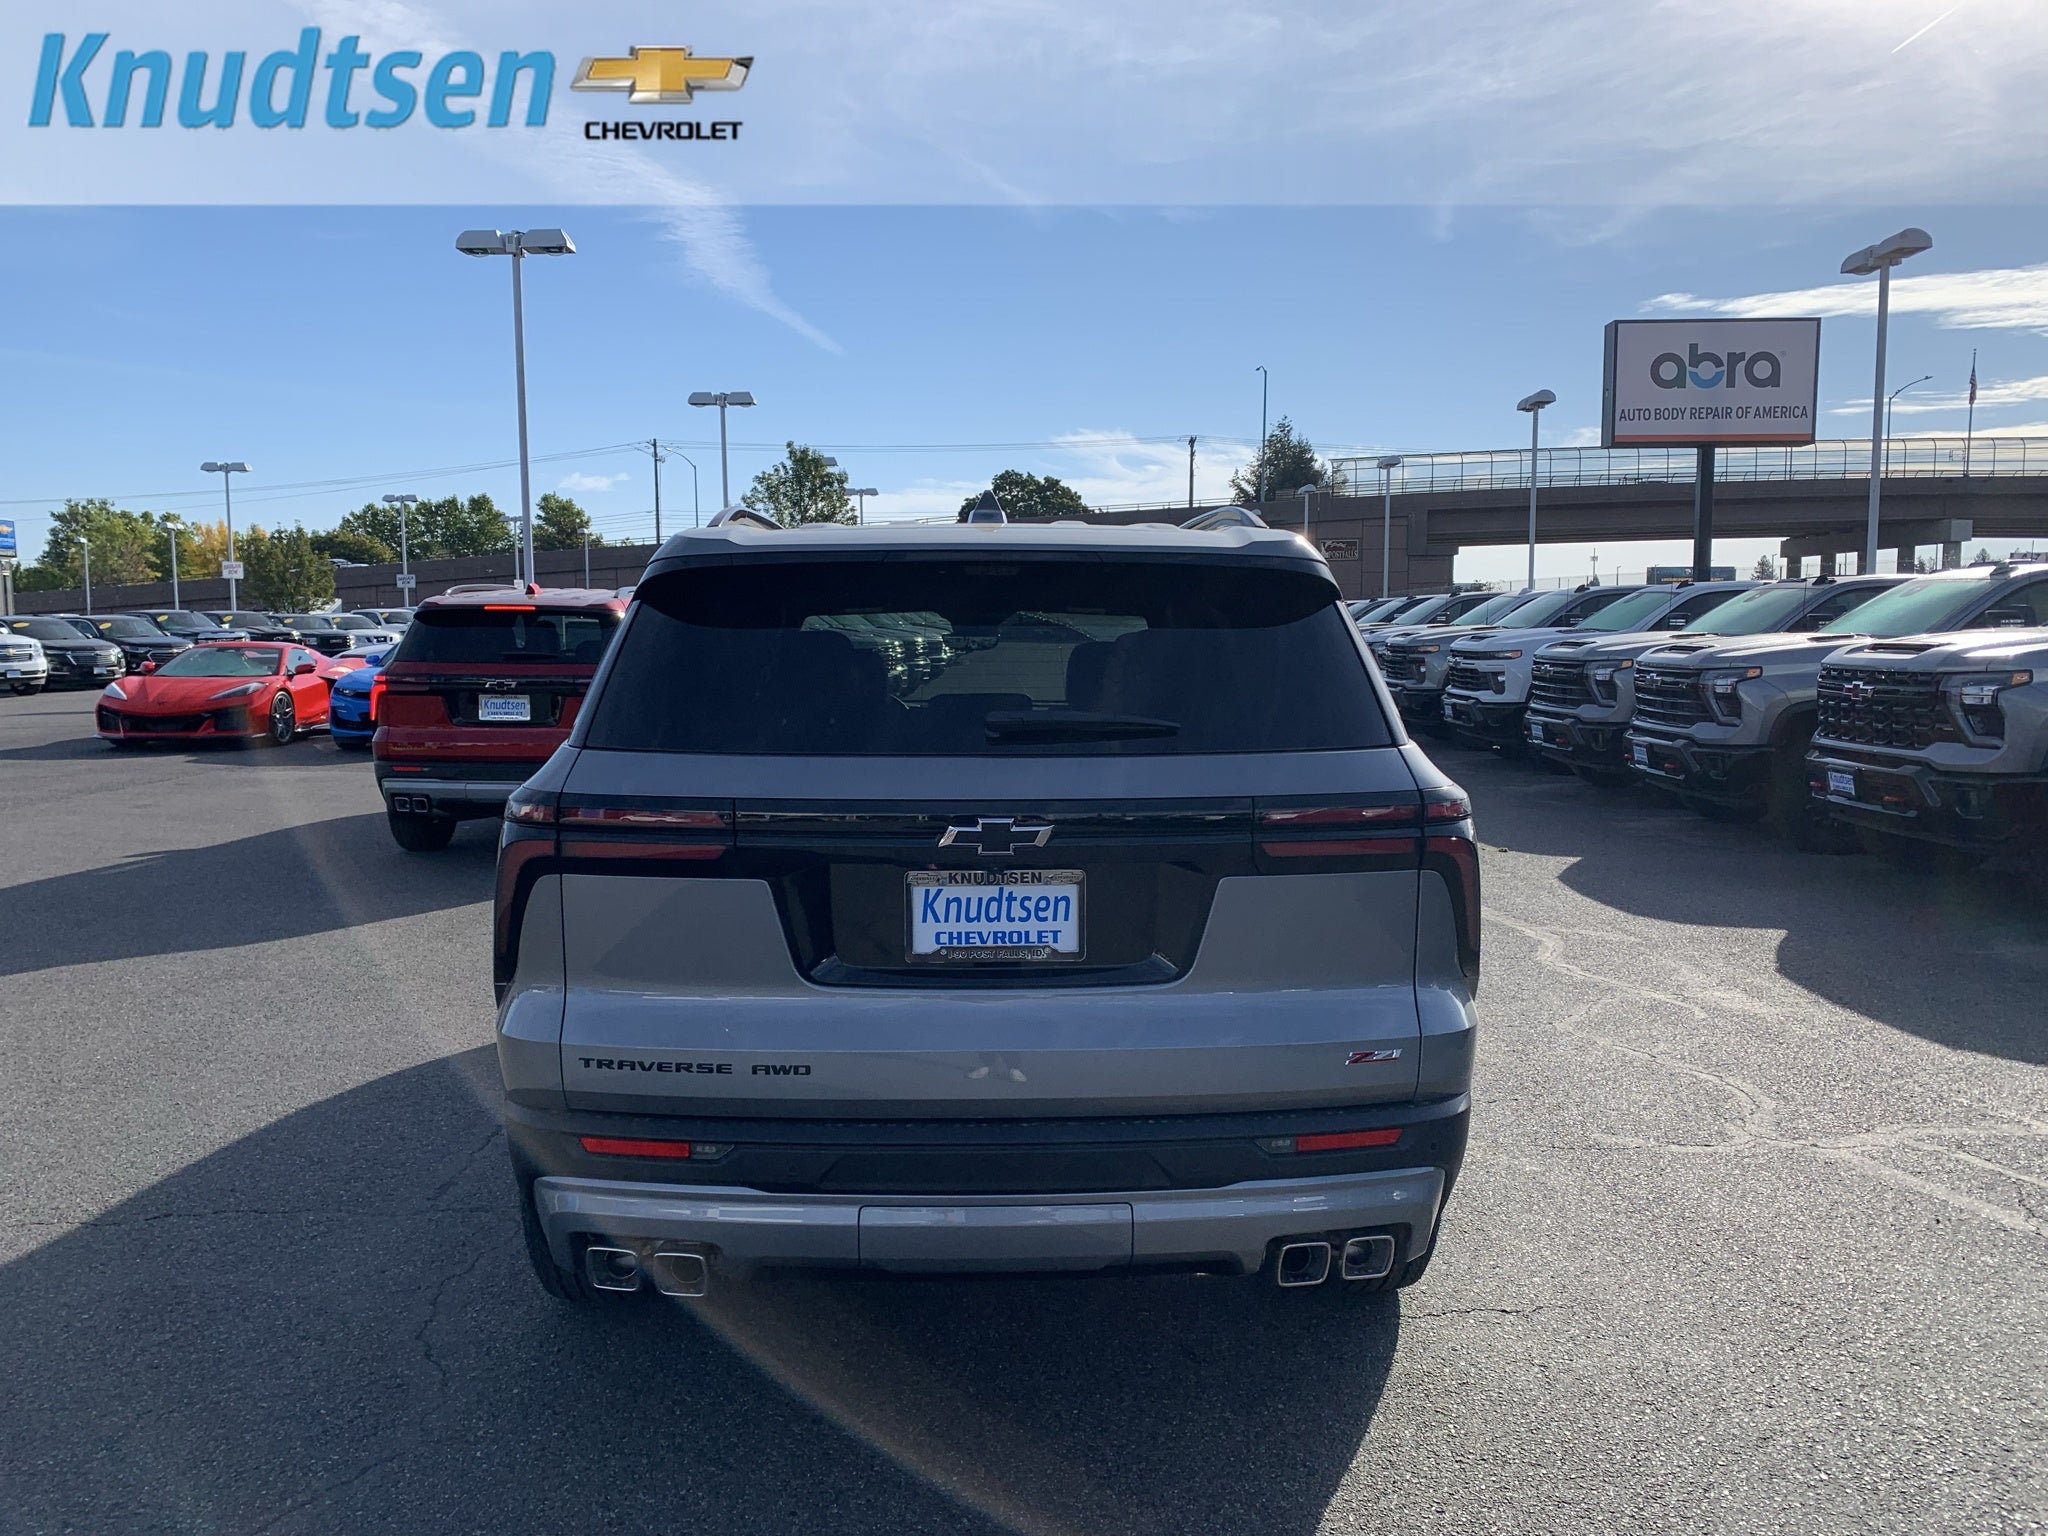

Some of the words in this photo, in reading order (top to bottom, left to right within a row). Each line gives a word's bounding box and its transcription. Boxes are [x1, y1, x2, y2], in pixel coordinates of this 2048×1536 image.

[1650, 343, 1781, 389] abra
[1619, 407, 1651, 422] AUTO
[1654, 407, 1687, 421] BODY
[1689, 406, 1733, 420] REPAIR
[1735, 406, 1752, 419] OF
[1753, 405, 1809, 419] AMERICA
[484, 700, 526, 710] Knudtsen
[948, 872, 1042, 884] KNUDTSEN
[921, 887, 1071, 924] Knudtsen
[934, 930, 1062, 945] CHEVROLET
[969, 949, 995, 959] POST
[1345, 1049, 1403, 1065] Z71
[578, 1057, 733, 1075] TRAVERSE
[751, 1064, 811, 1076] AWD
